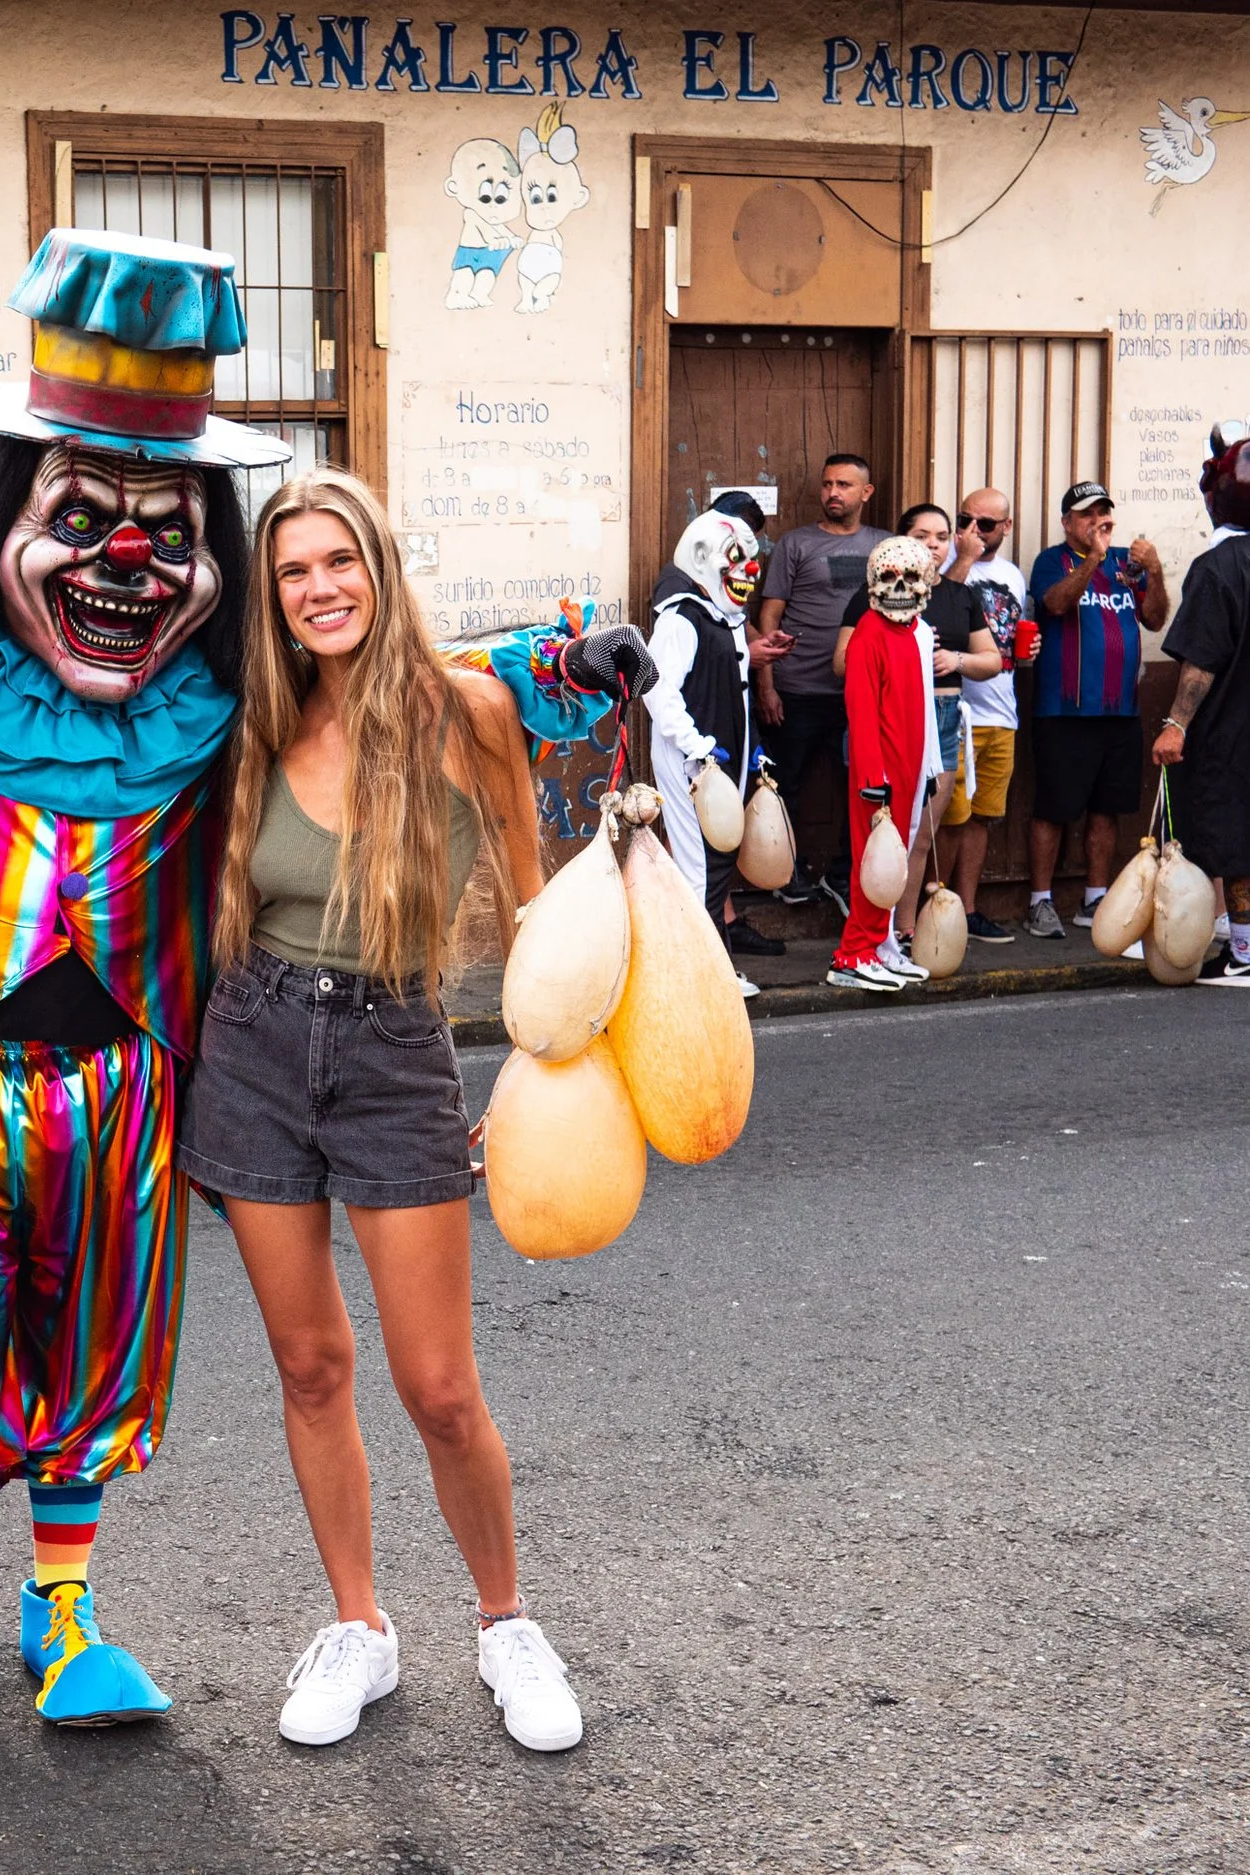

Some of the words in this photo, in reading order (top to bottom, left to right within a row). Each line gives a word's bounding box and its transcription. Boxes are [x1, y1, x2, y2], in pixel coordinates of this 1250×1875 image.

[220, 10, 643, 99] PAÑALERA
[681, 30, 779, 103] EL
[823, 36, 1079, 115] PARQUE
[1118, 308, 1147, 331] todo
[1154, 312, 1183, 334] para
[1199, 308, 1248, 332] cuidado
[1180, 338, 1209, 361] para
[456, 390, 550, 424] Horario
[421, 495, 462, 517] dom
[496, 495, 510, 516] 8
[433, 577, 494, 603] surtido
[504, 573, 575, 602] completo
[1079, 590, 1136, 613] BARÇA
